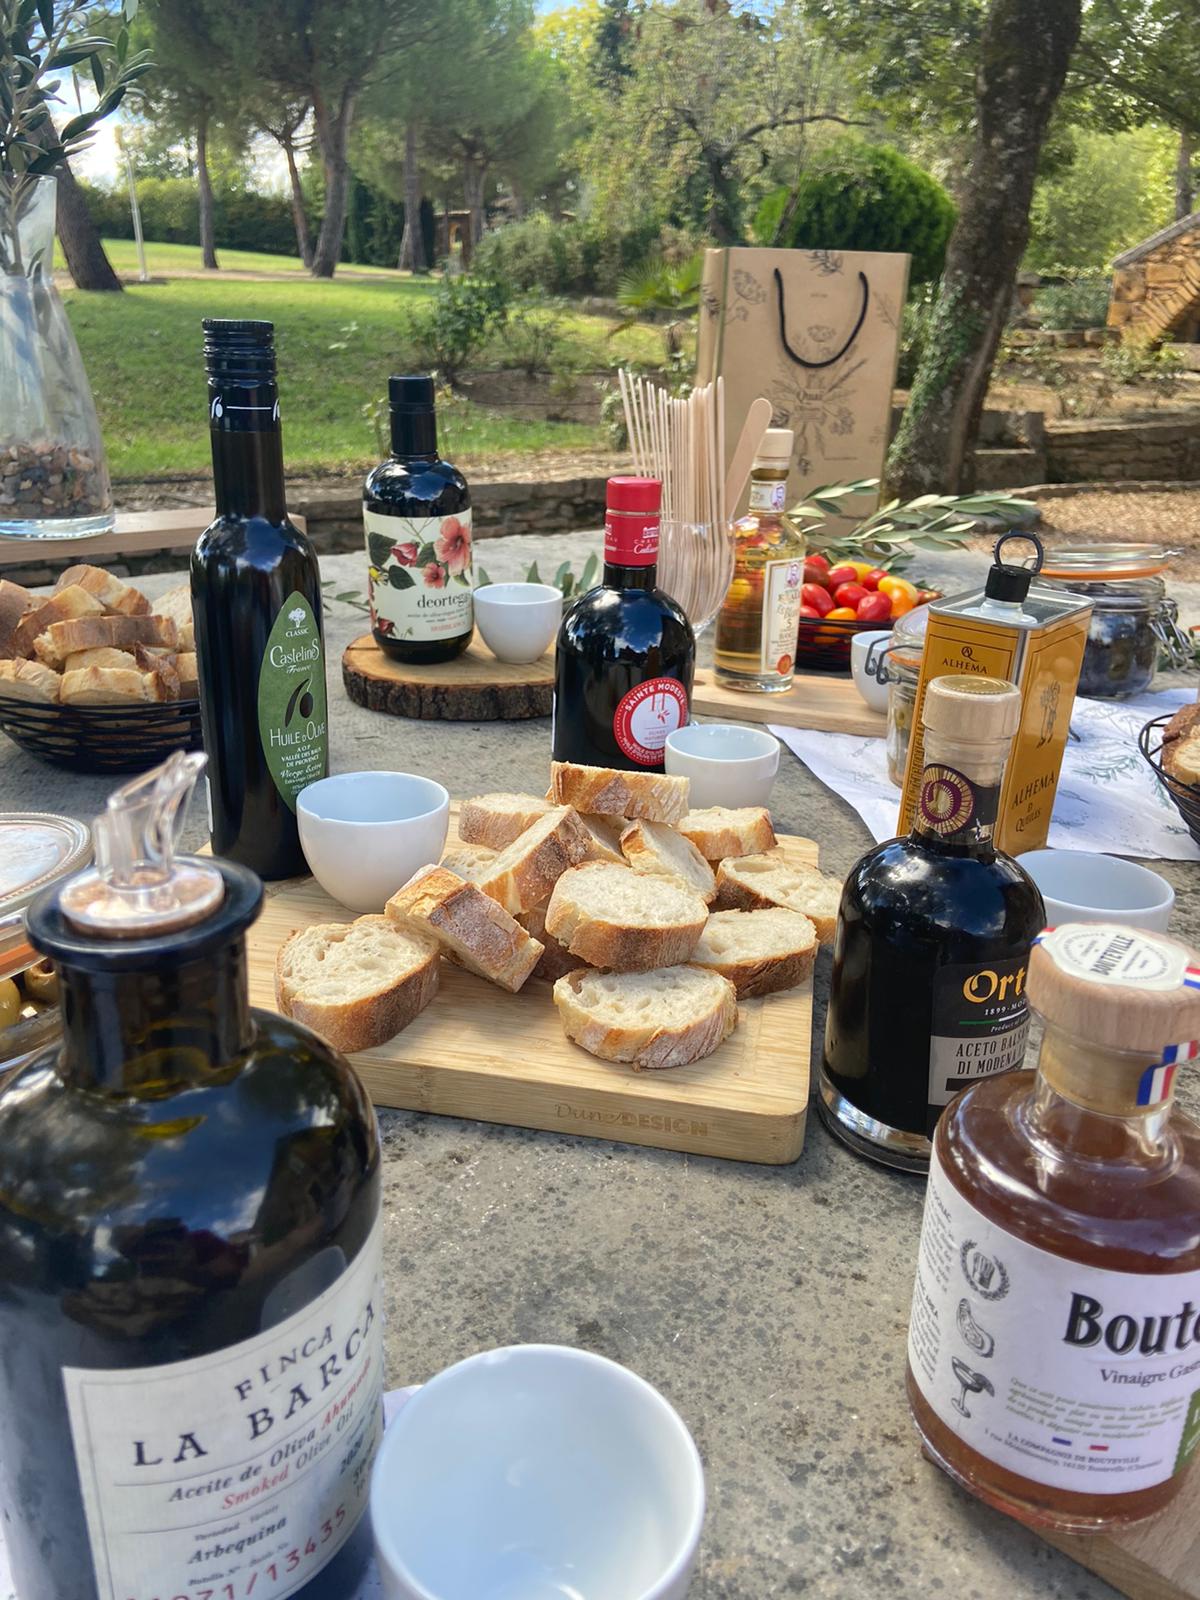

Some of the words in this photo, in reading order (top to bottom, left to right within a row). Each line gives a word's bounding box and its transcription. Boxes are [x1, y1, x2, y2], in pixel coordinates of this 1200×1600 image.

[285, 627, 309, 638] CLASSIC
[942, 657, 988, 674] ALHEMA
[624, 685, 655, 712] SAINTE
[1010, 771, 1055, 810] ALHEMA
[956, 1040, 997, 1058] ACETO
[957, 1060, 971, 1075] DI
[234, 1324, 333, 1401] FINCA
[1100, 1368, 1167, 1388] Vinaigre
[133, 1432, 208, 1466] LA
[247, 1301, 375, 1440] BARCA
[168, 1476, 232, 1502] Aceite
[239, 1465, 262, 1482] de
[269, 1427, 316, 1468] Oliva
[221, 1464, 290, 1510] Smoked
[295, 1433, 332, 1470] Olive
[187, 1517, 287, 1564] Arbequina
